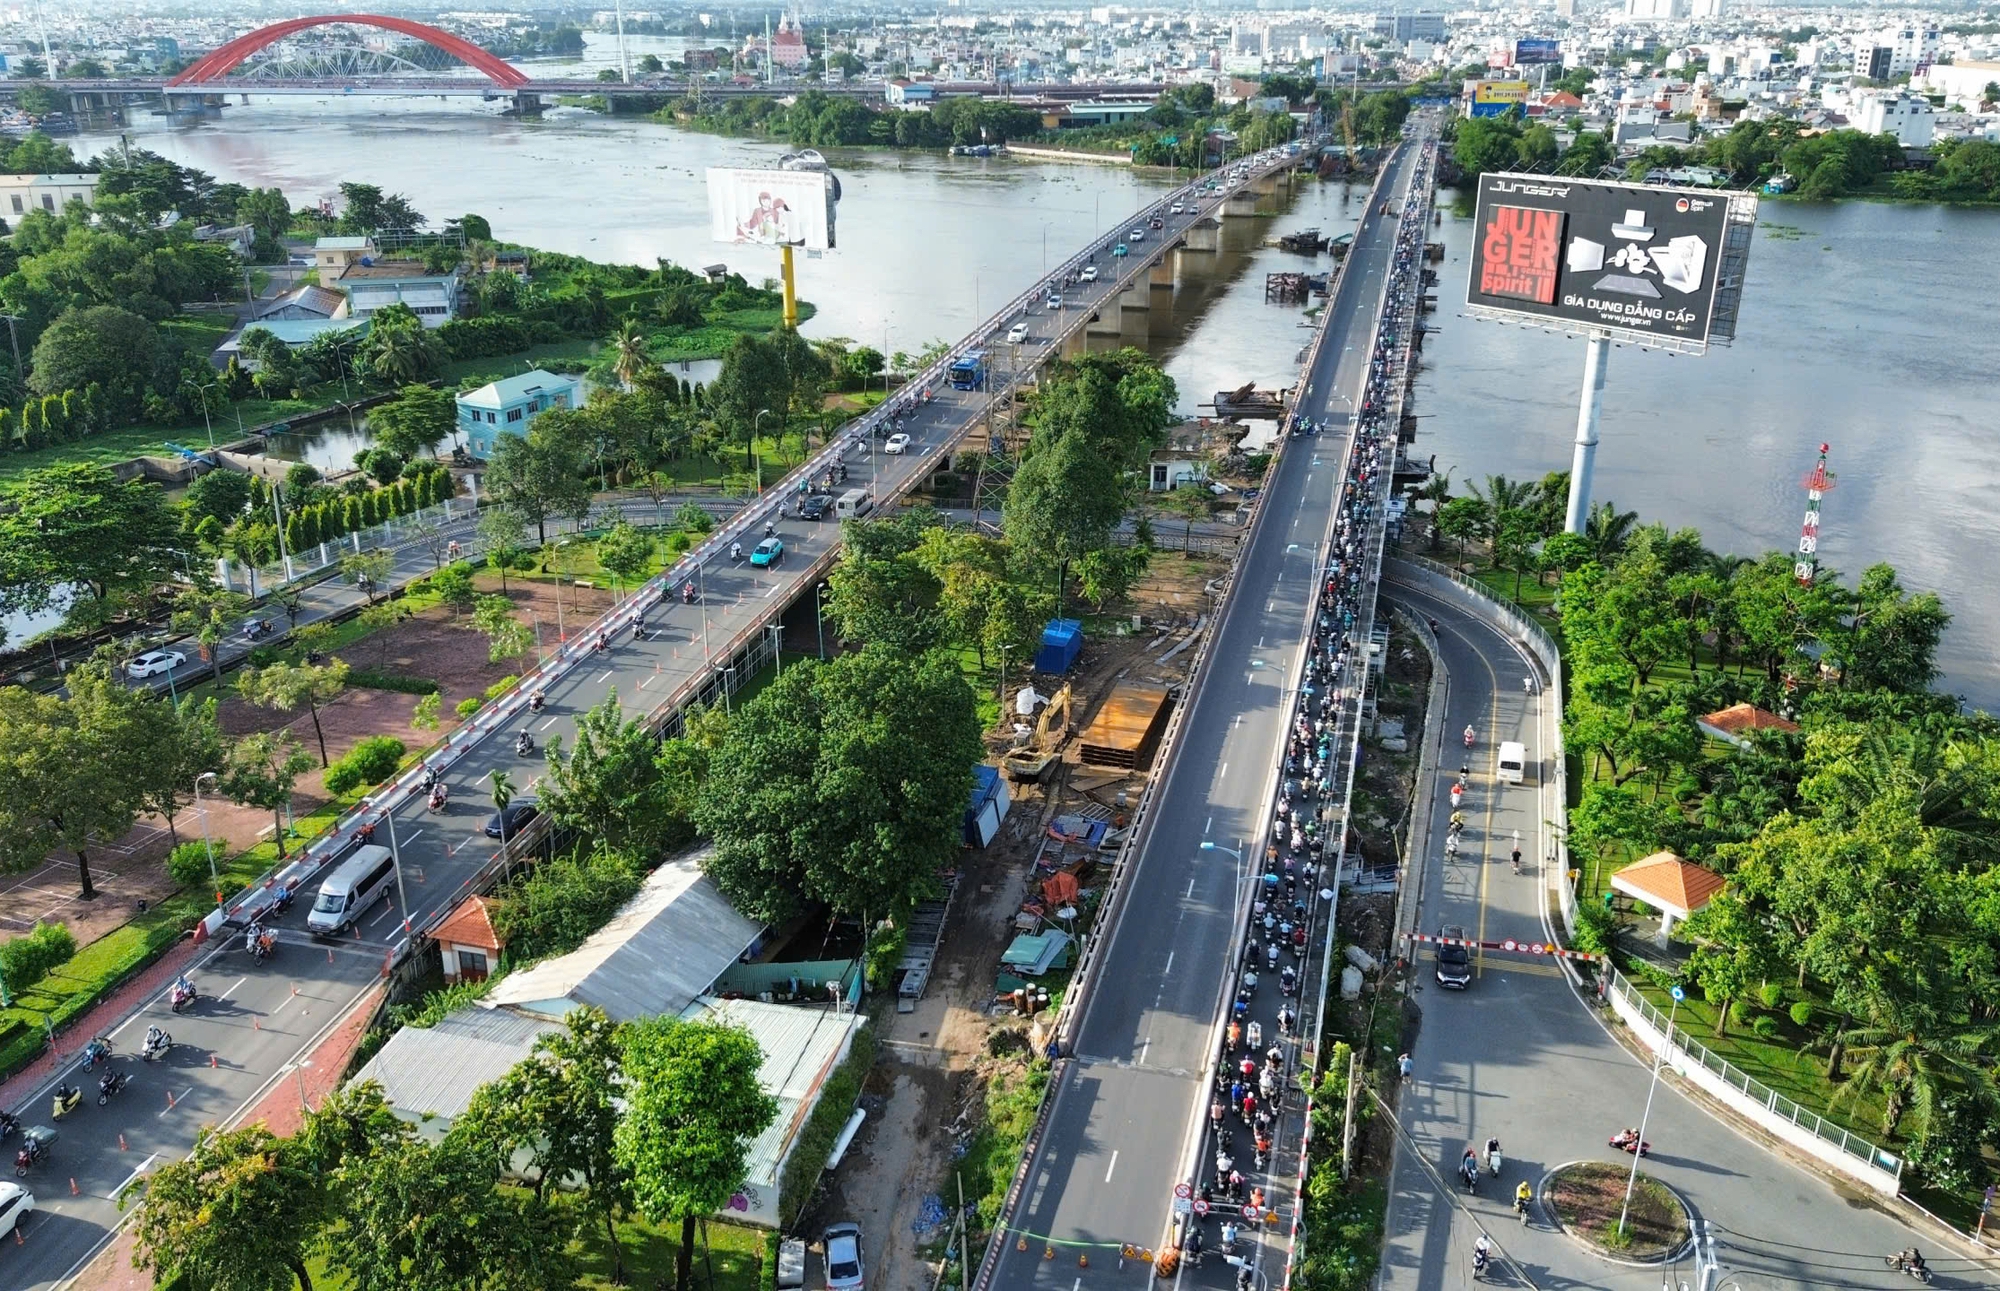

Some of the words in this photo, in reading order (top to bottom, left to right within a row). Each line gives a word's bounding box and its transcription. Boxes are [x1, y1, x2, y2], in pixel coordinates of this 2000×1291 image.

[1489, 181, 1570, 198] JUNGER
[1486, 206, 1558, 241] JUN
[1483, 233, 1557, 270] GER
[1600, 312, 1652, 326] www.junger.vn
[1665, 307, 1696, 323] CẤP
